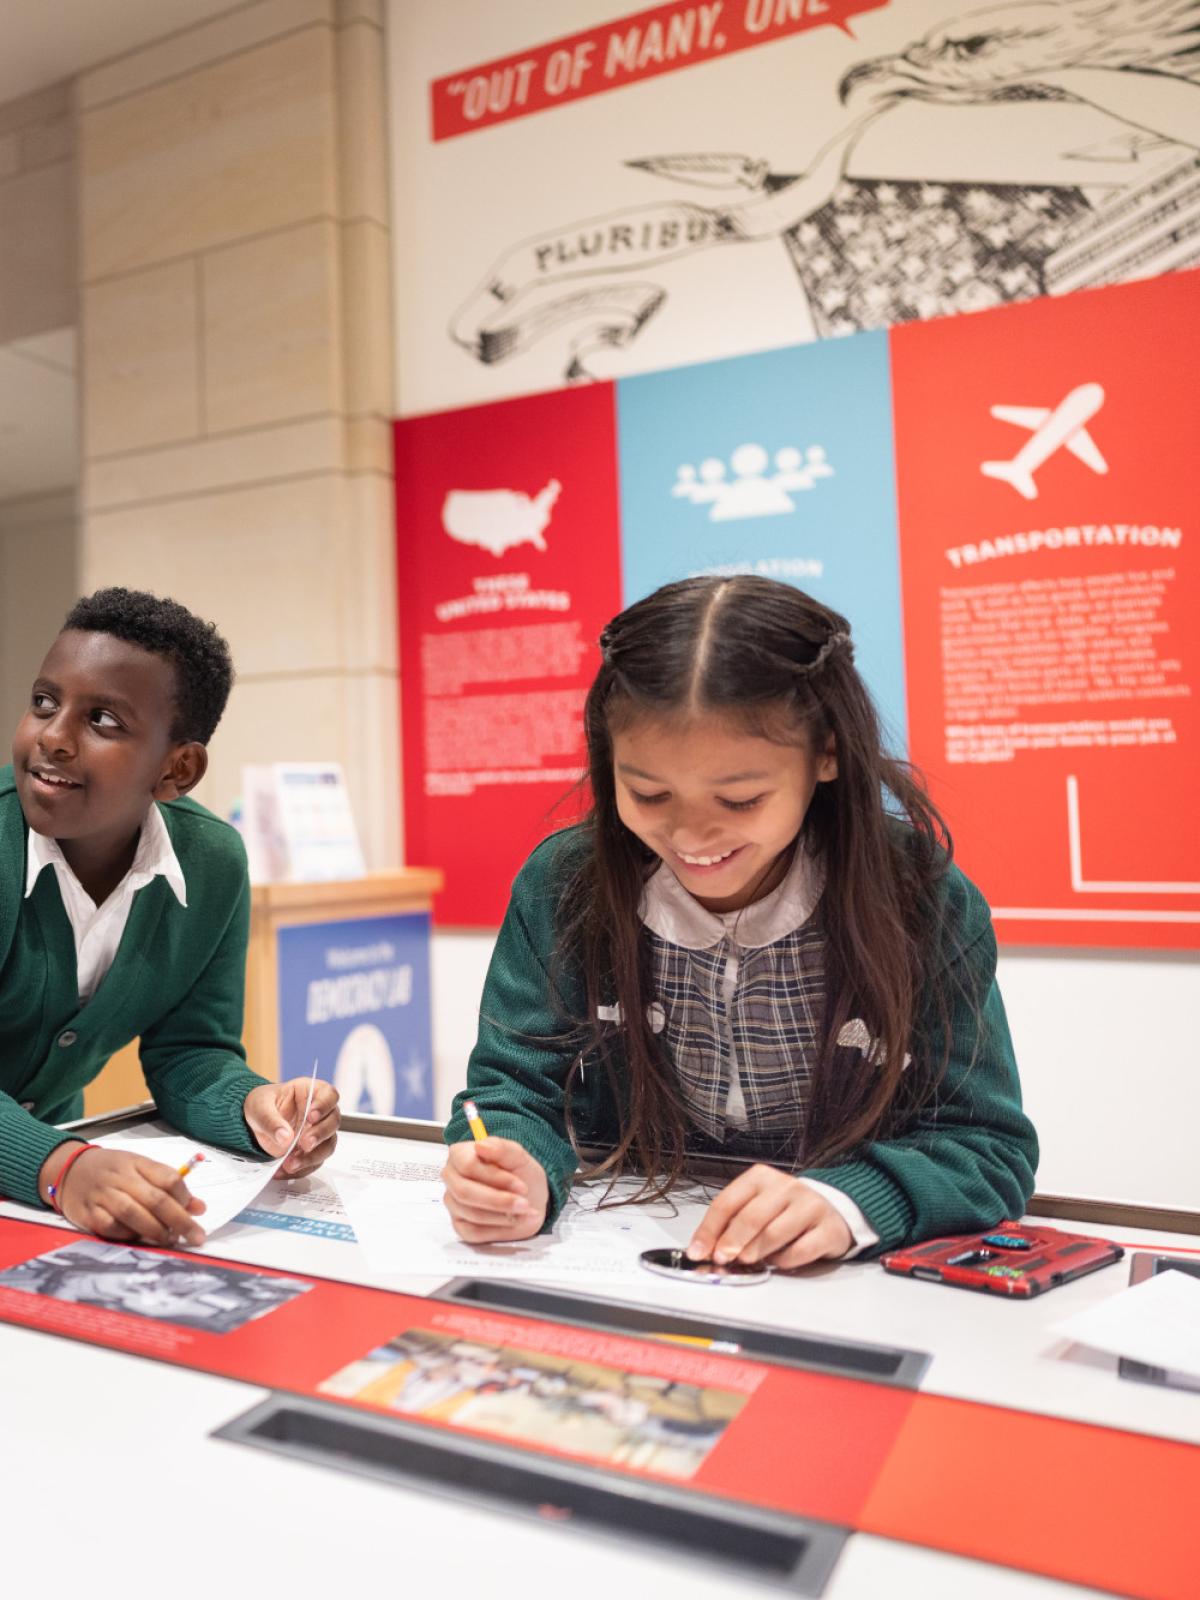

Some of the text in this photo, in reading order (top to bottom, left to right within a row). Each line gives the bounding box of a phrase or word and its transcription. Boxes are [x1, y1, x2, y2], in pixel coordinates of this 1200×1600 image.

[543, 41, 597, 97] OF
[604, 2, 727, 80] MANY,
[945, 524, 1182, 569] TRANSPORTATION
[435, 589, 571, 622] UNITED STATES
